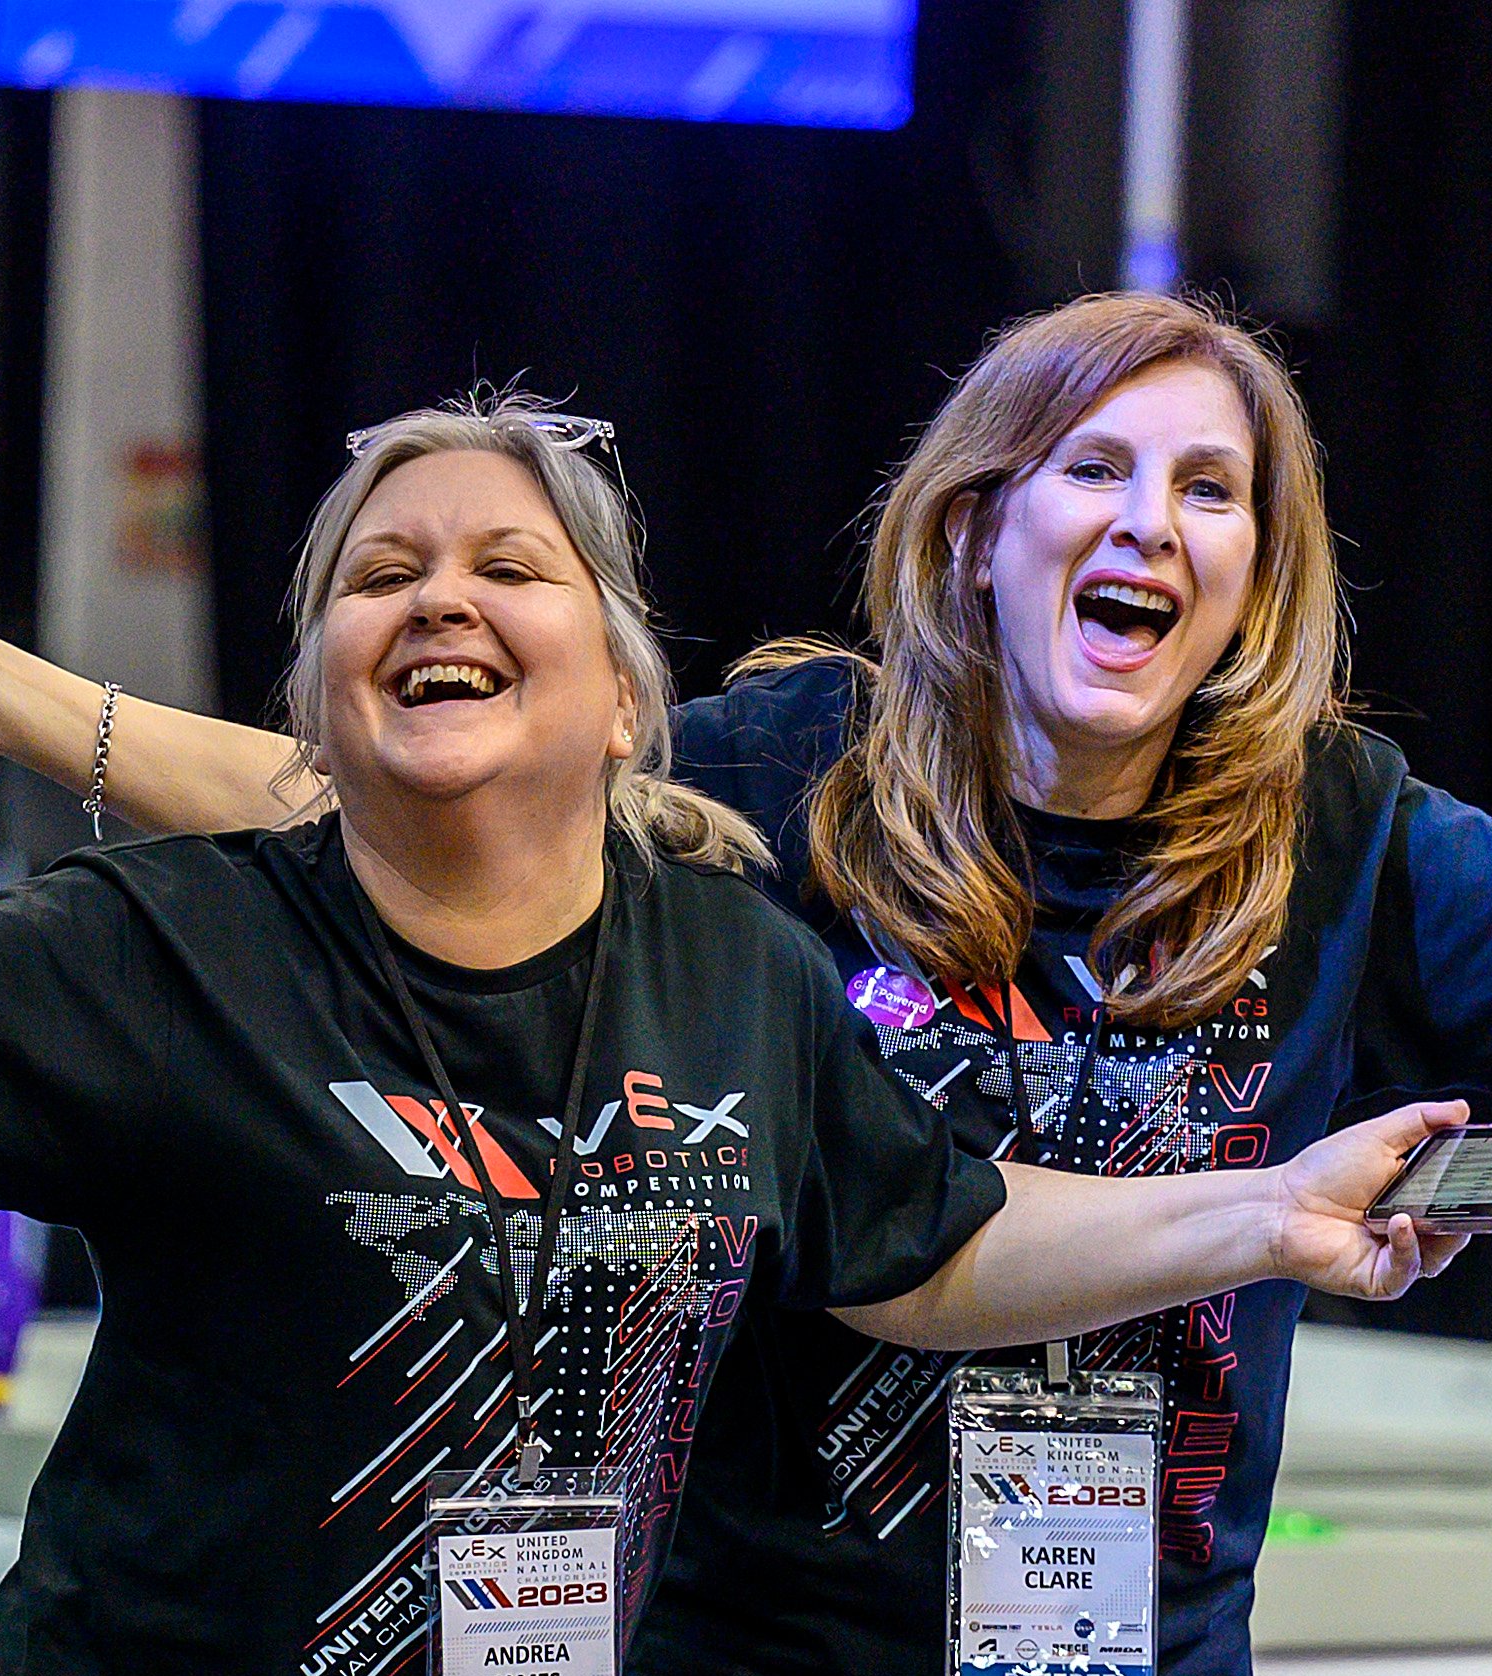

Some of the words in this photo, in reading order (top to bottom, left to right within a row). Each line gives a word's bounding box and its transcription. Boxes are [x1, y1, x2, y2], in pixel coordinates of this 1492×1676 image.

[1064, 1023, 1270, 1048] CMPEITION
[536, 1070, 749, 1156] VEX
[574, 1174, 750, 1197] OMPETITION
[1160, 1062, 1273, 1562] VONTEER
[817, 1353, 914, 1461] UNITED
[976, 1436, 1035, 1456] VEX
[1047, 1437, 1102, 1448] UNITED
[1047, 1465, 1145, 1474] NATIONAL
[1047, 1475, 1146, 1483] CHAMPIONSHIP
[1047, 1485, 1146, 1506] 2023
[450, 1540, 506, 1561] VEX
[516, 1535, 567, 1548] UNITED
[516, 1548, 583, 1562] KINGDOM
[1022, 1546, 1095, 1565] KAREN
[517, 1561, 607, 1574] NATIONAL
[517, 1573, 607, 1585] CHAMPIONSHIP
[1025, 1571, 1093, 1589] CLARE
[518, 1582, 608, 1607] 2023
[484, 1643, 570, 1666] ANDREA
